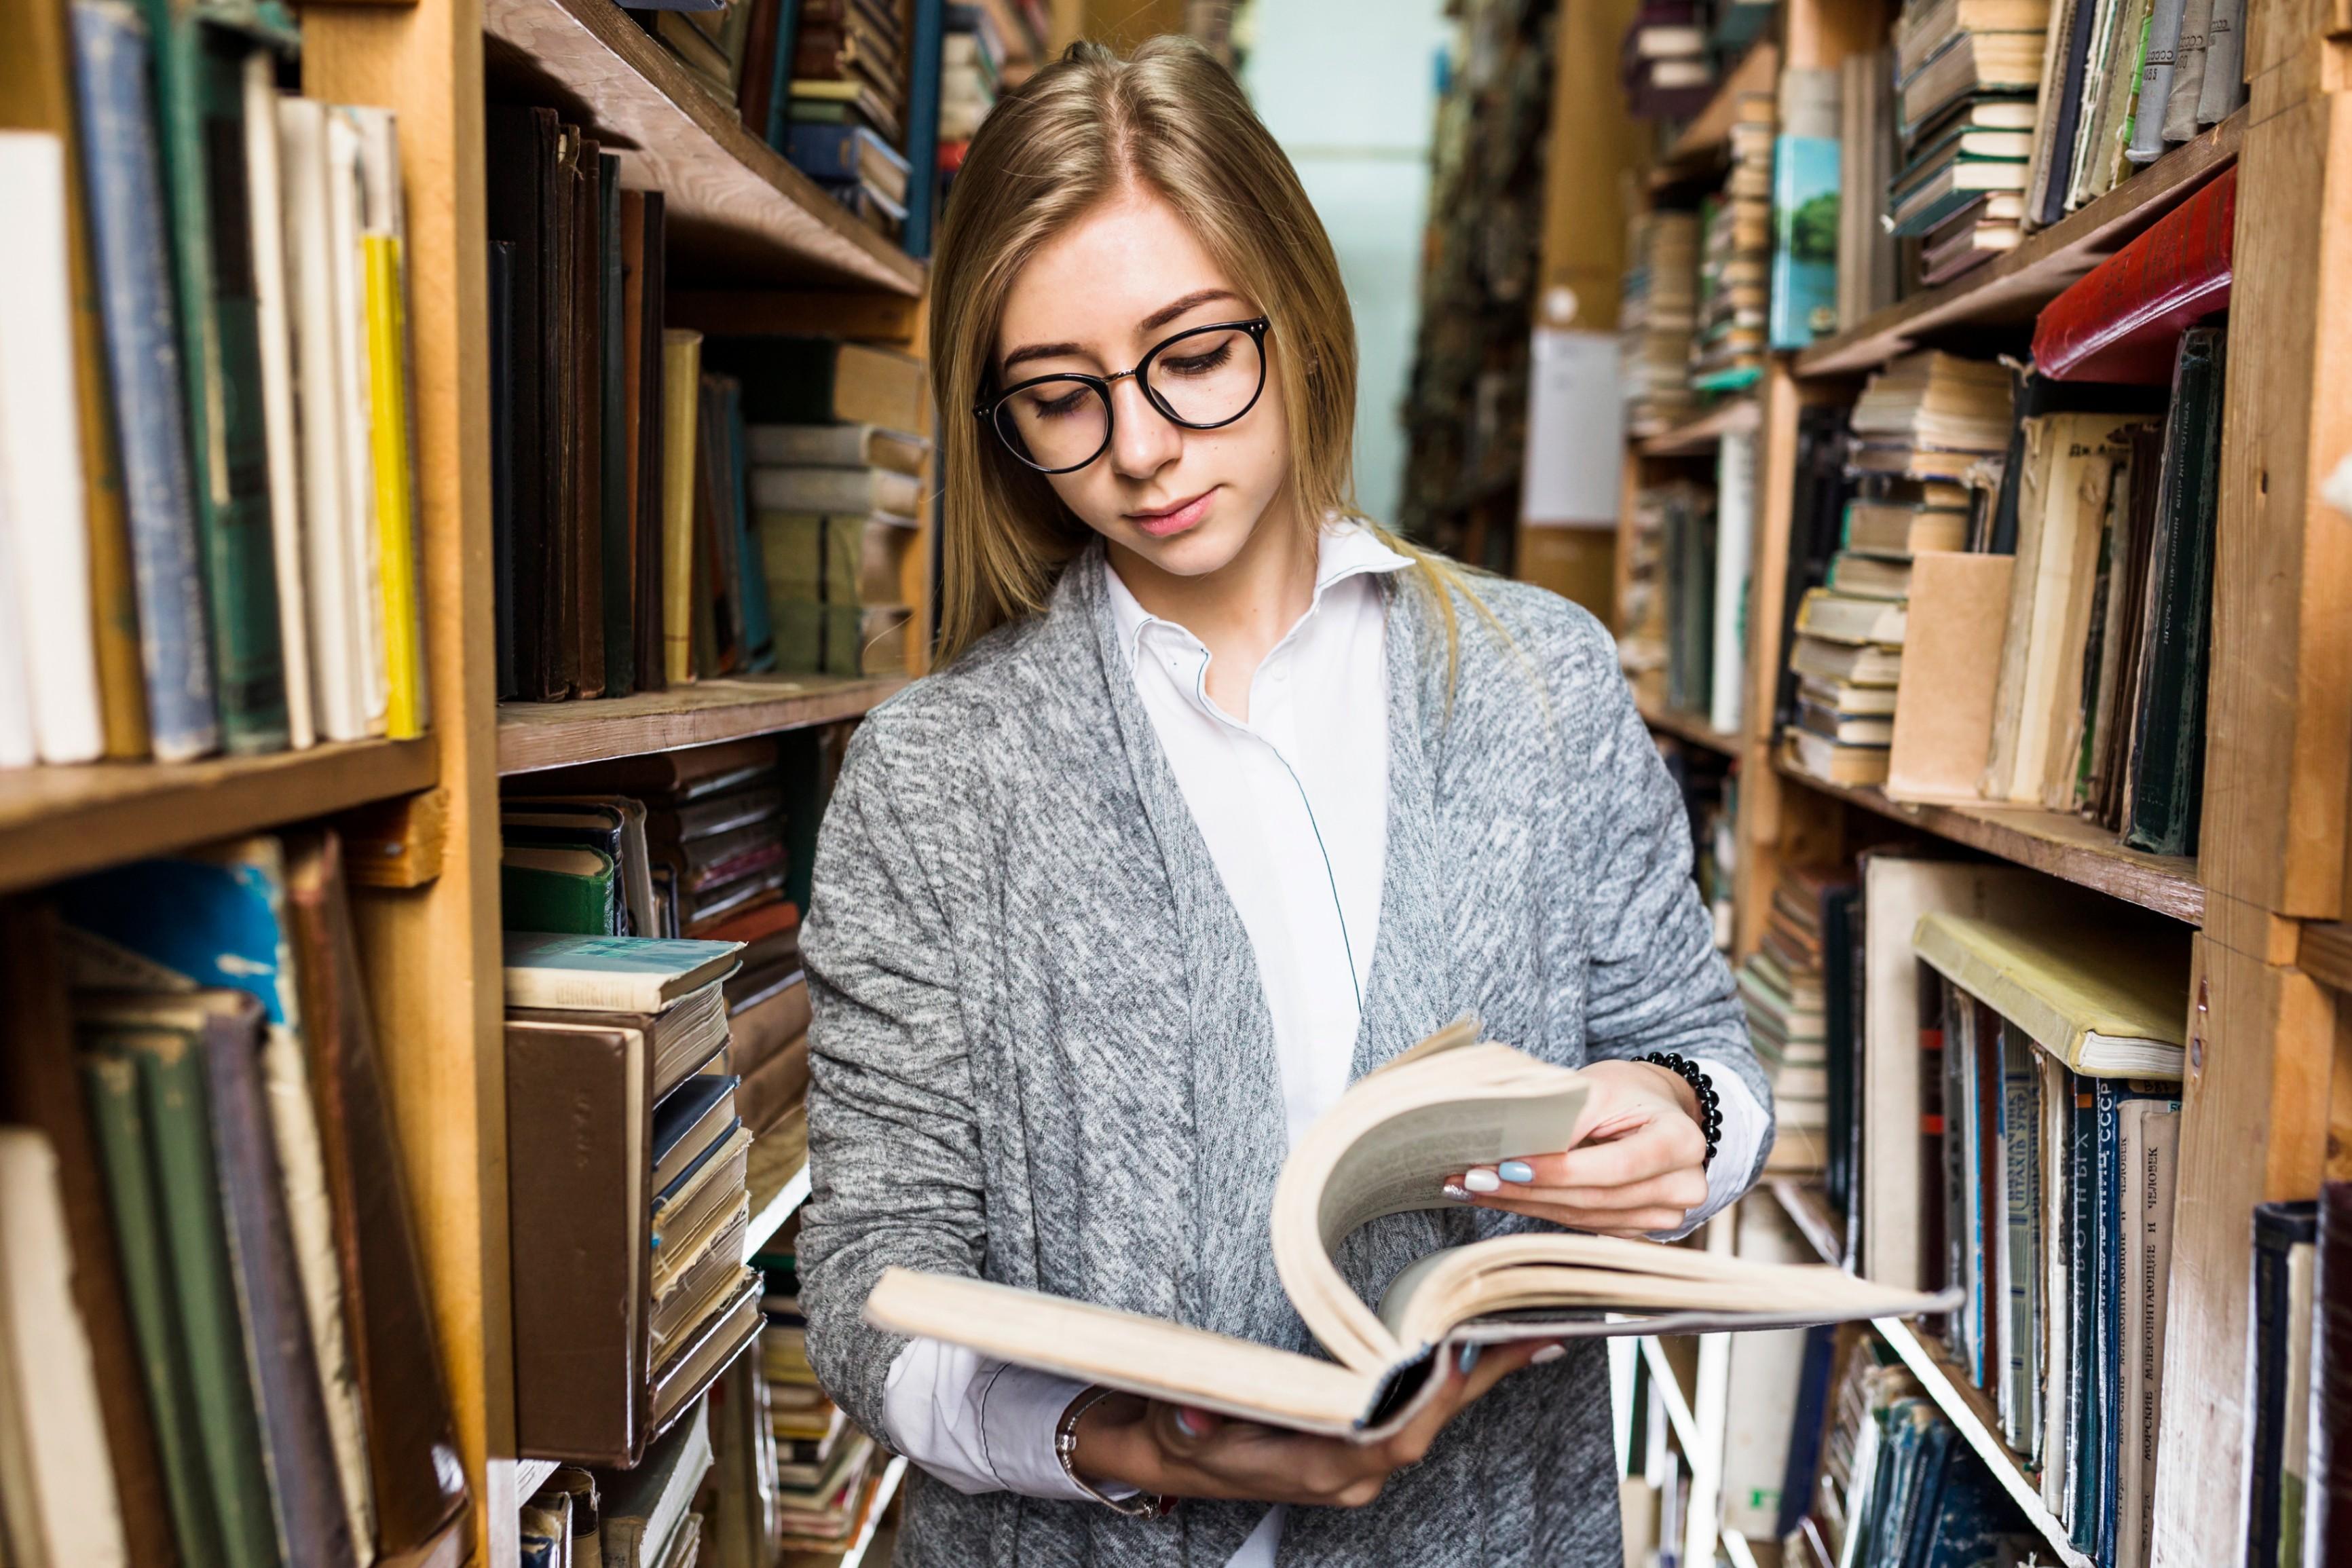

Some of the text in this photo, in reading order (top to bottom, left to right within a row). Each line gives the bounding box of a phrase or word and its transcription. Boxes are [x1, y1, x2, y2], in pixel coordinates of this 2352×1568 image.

[2163, 604, 2172, 644] ИГОРЬ
[2100, 1083, 2112, 1142] СССР
[2148, 1146, 2159, 1209] ЧЕЛОВЕК
[2148, 1222, 2157, 1233] И
[2145, 1244, 2157, 1381] МЛЕКОПИТАЮЩИЕ
[2144, 1392, 2153, 1461] МОРСКИЕ
